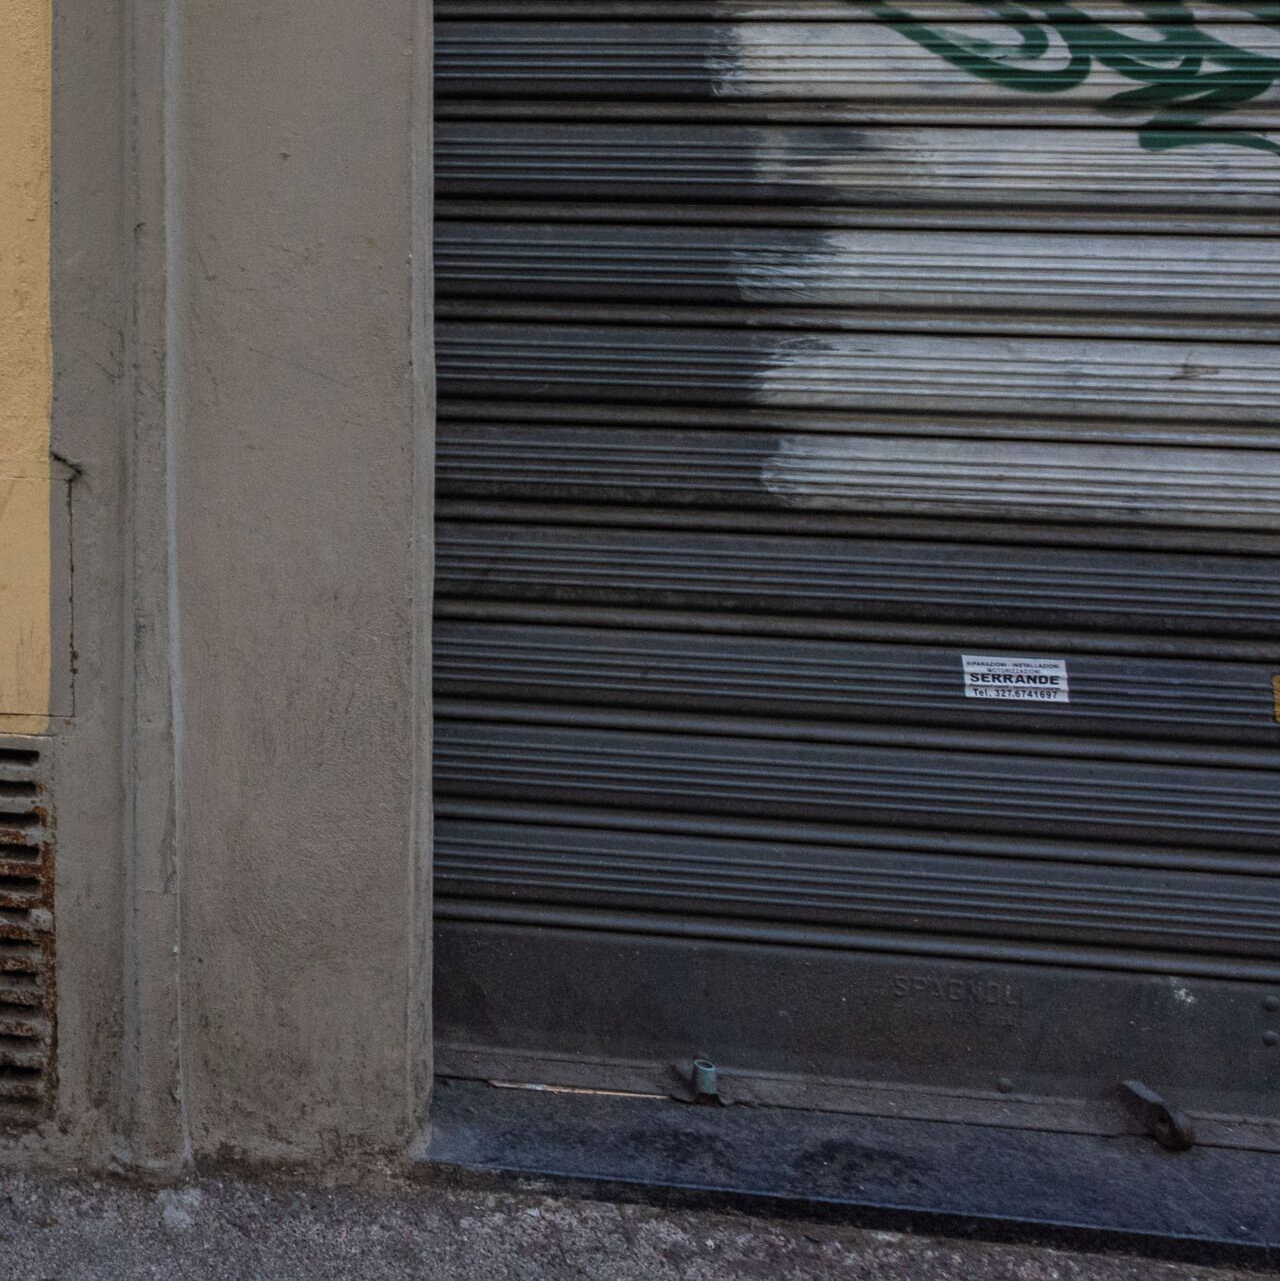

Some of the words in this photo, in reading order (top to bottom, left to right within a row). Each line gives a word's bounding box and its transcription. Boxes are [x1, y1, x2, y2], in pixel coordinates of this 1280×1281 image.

[970, 673, 1060, 685] SERRANDE
[972, 688, 992, 697] Tel.
[994, 689, 1058, 699] 327.6741697
